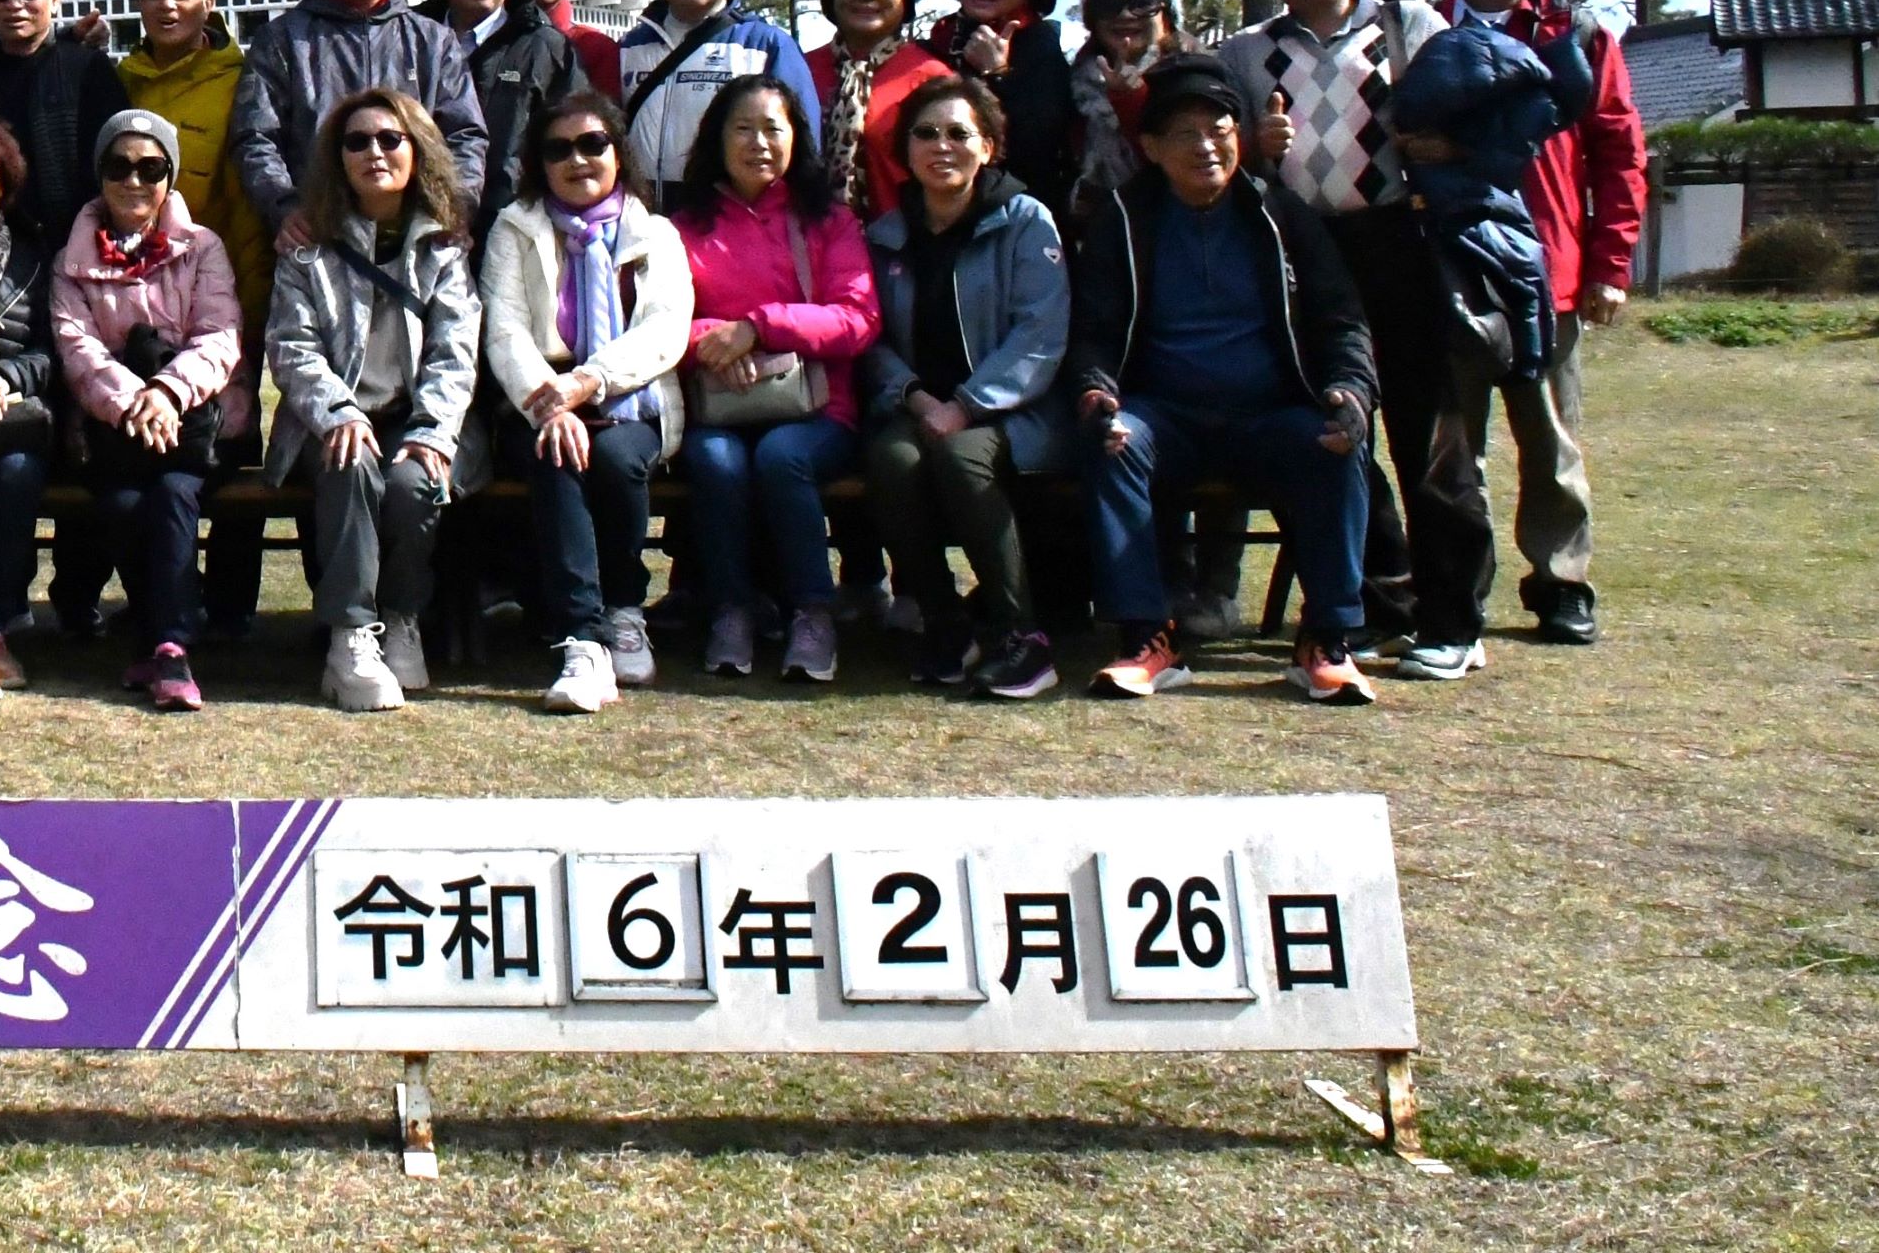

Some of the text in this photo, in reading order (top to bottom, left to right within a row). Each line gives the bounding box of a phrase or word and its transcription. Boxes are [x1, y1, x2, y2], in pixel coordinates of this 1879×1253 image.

[333, 871, 1349, 995] 令和6年2月26日
